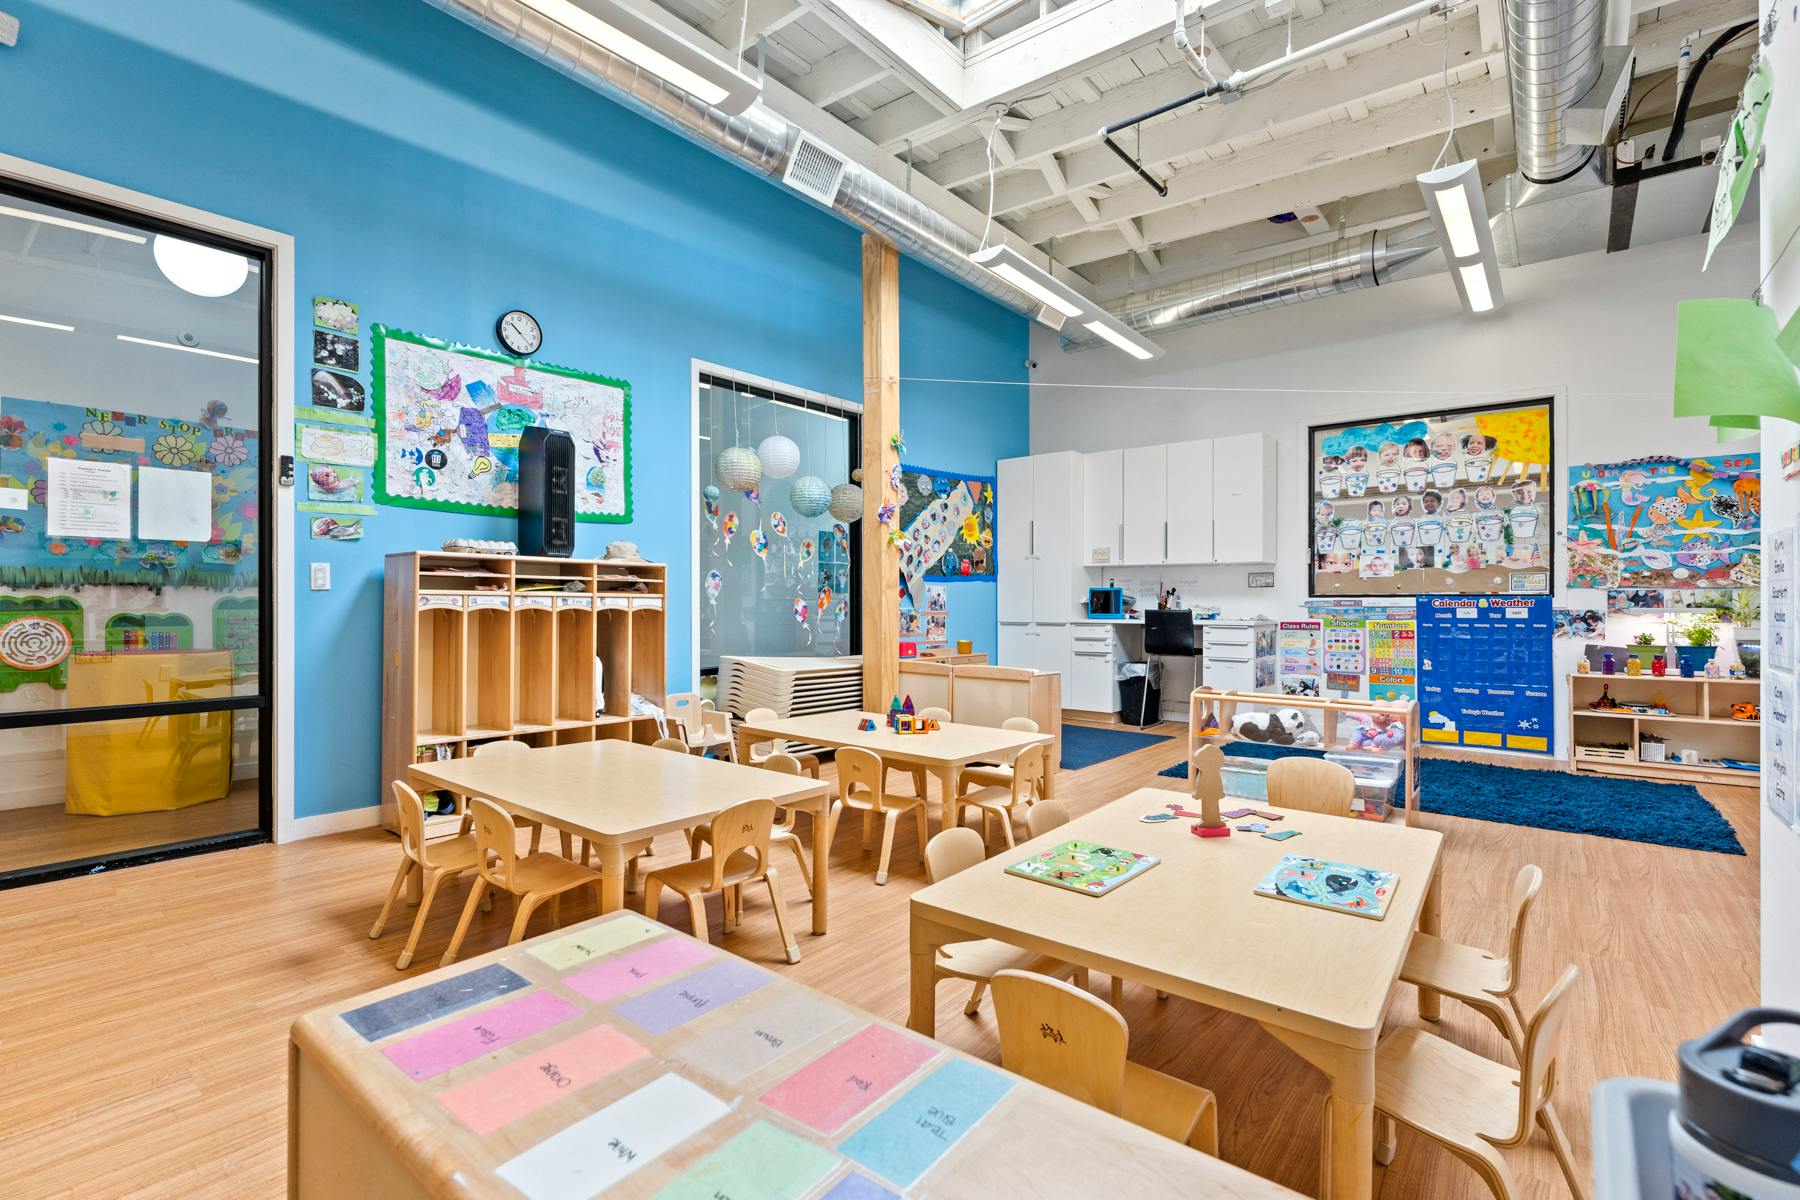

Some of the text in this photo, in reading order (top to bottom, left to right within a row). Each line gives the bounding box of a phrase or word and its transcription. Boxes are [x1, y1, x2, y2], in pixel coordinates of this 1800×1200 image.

[159, 420, 201, 436] STOP
[1650, 466, 1676, 475] THE
[1723, 458, 1755, 467] SEA
[1432, 599, 1477, 608] Calendar
[1478, 599, 1488, 607] &
[1491, 599, 1535, 608] Weather
[754, 1029, 785, 1049] Brown
[539, 1061, 572, 1089] Orange
[847, 1074, 873, 1092] Red
[608, 1137, 638, 1164] White
